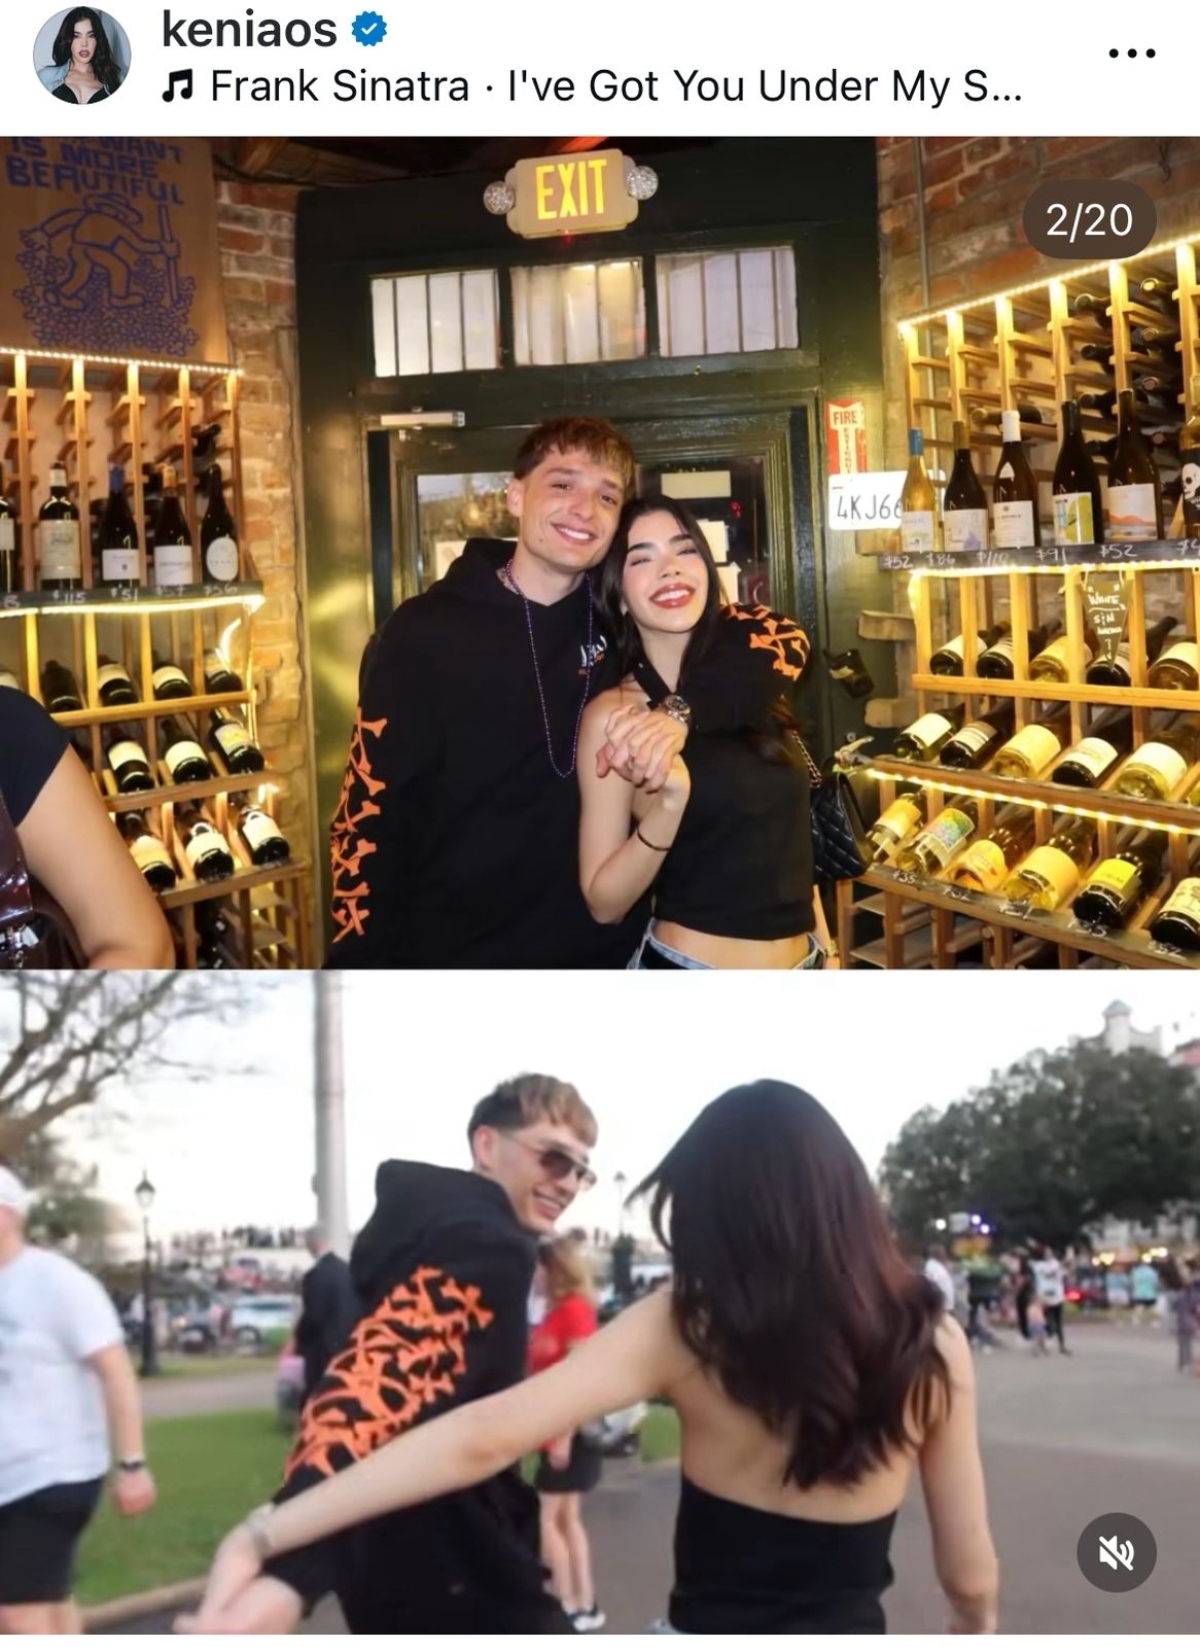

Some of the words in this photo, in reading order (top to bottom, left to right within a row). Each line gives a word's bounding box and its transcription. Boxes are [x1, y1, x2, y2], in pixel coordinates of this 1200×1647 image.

[60, 143, 159, 179] MORE
[6, 154, 185, 206] BEAUTIFUL
[535, 158, 608, 220] EXIT
[833, 410, 858, 425] FIRE
[1035, 547, 1067, 564] $91
[1100, 543, 1138, 559] $52
